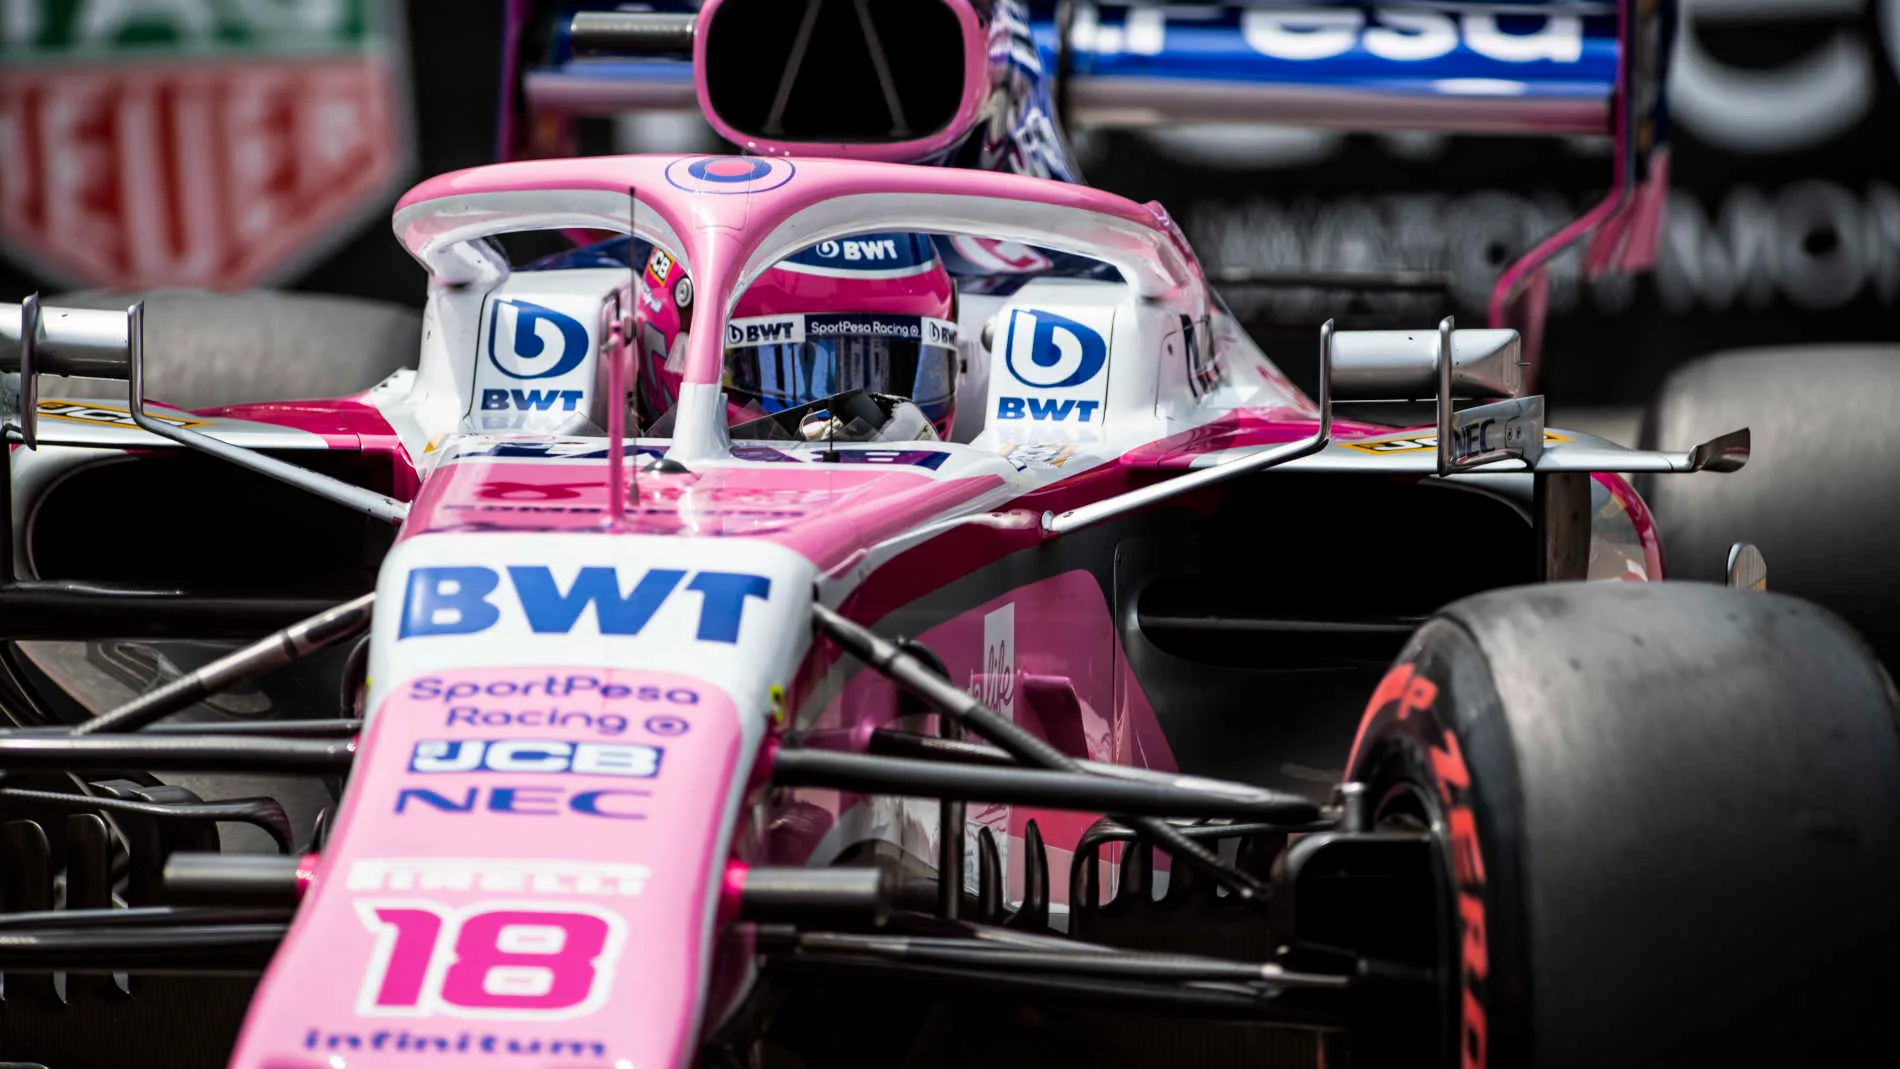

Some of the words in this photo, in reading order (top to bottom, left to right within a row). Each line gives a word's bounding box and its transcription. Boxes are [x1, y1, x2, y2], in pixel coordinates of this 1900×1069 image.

[843, 239, 898, 260] BWT
[650, 249, 671, 281] CB
[746, 322, 793, 342] BWT
[811, 322, 872, 336] SportPesa
[873, 322, 909, 337] Racing
[481, 388, 583, 411] BWT
[997, 397, 1099, 422] BWT
[398, 565, 771, 645] BWT
[409, 675, 701, 704] SportPesa
[445, 706, 628, 735] Racing
[411, 740, 660, 778] JCB
[394, 786, 653, 821] NEC
[355, 899, 626, 1018] 18
[303, 1028, 607, 1058] infinitum
